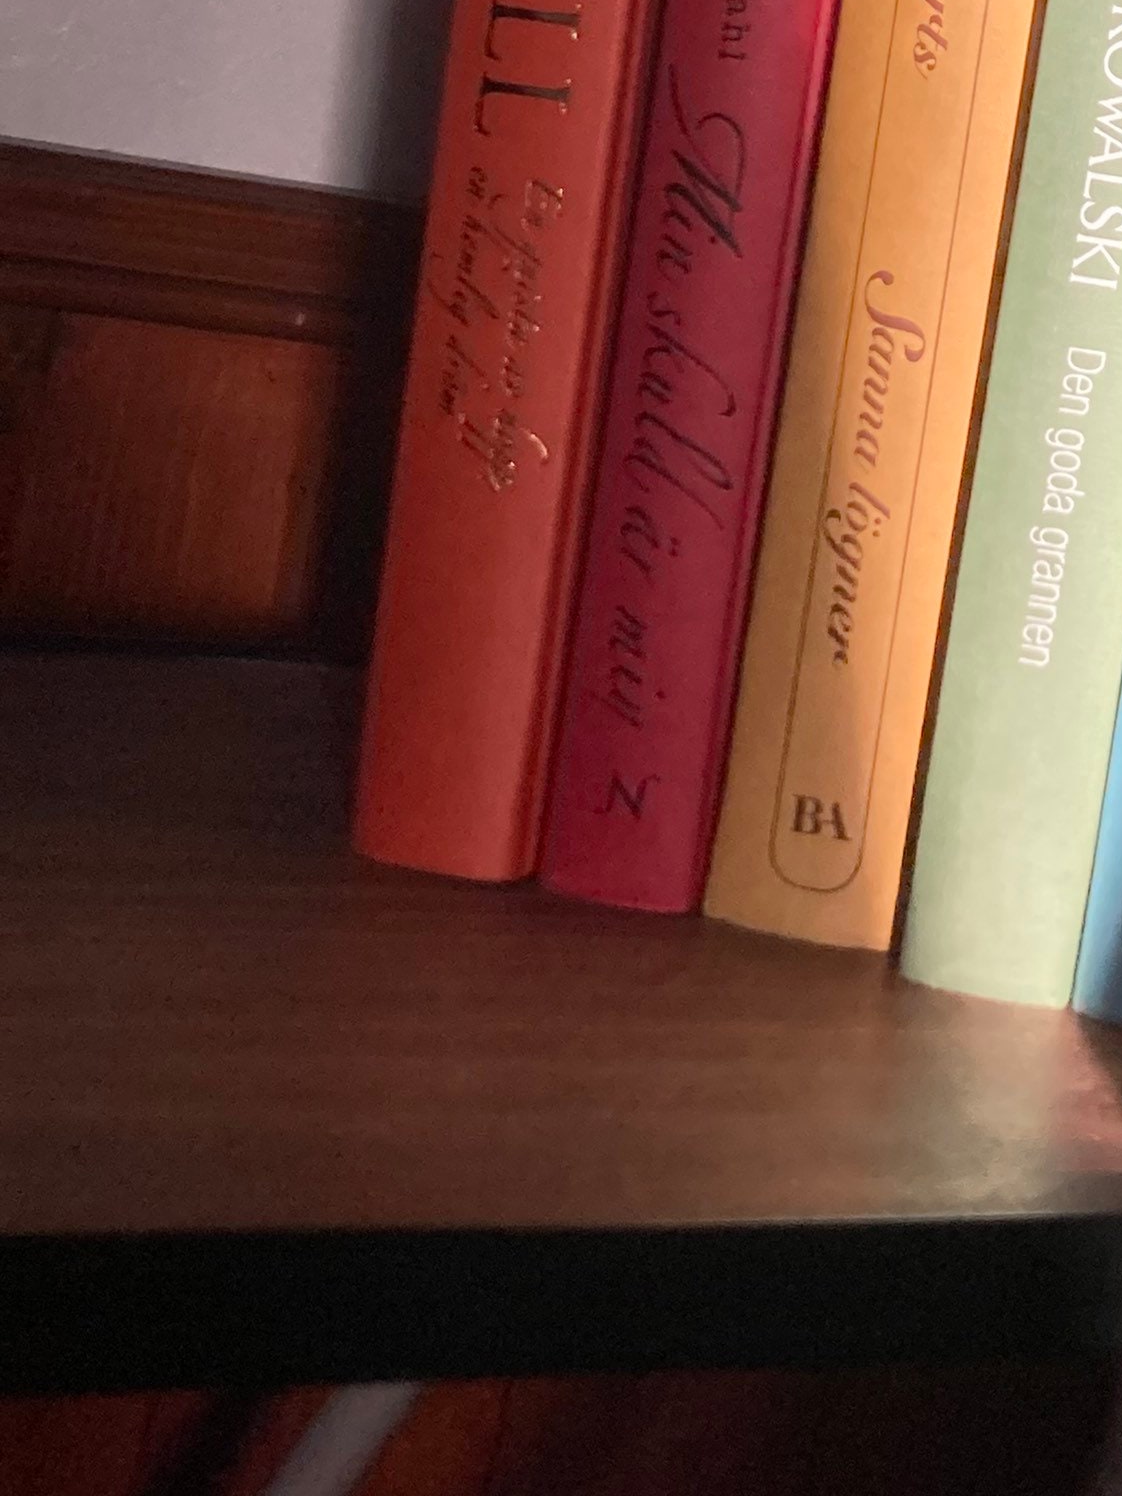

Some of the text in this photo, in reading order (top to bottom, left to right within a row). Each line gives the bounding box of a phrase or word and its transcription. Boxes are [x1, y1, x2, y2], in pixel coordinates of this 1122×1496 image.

[660, 63, 745, 277] Min
[622, 290, 735, 526] skuld
[824, 270, 926, 666] Sanna lögner
[1017, 345, 1107, 668] Den goda grannen
[618, 502, 680, 577] är
[791, 794, 853, 841] BA
